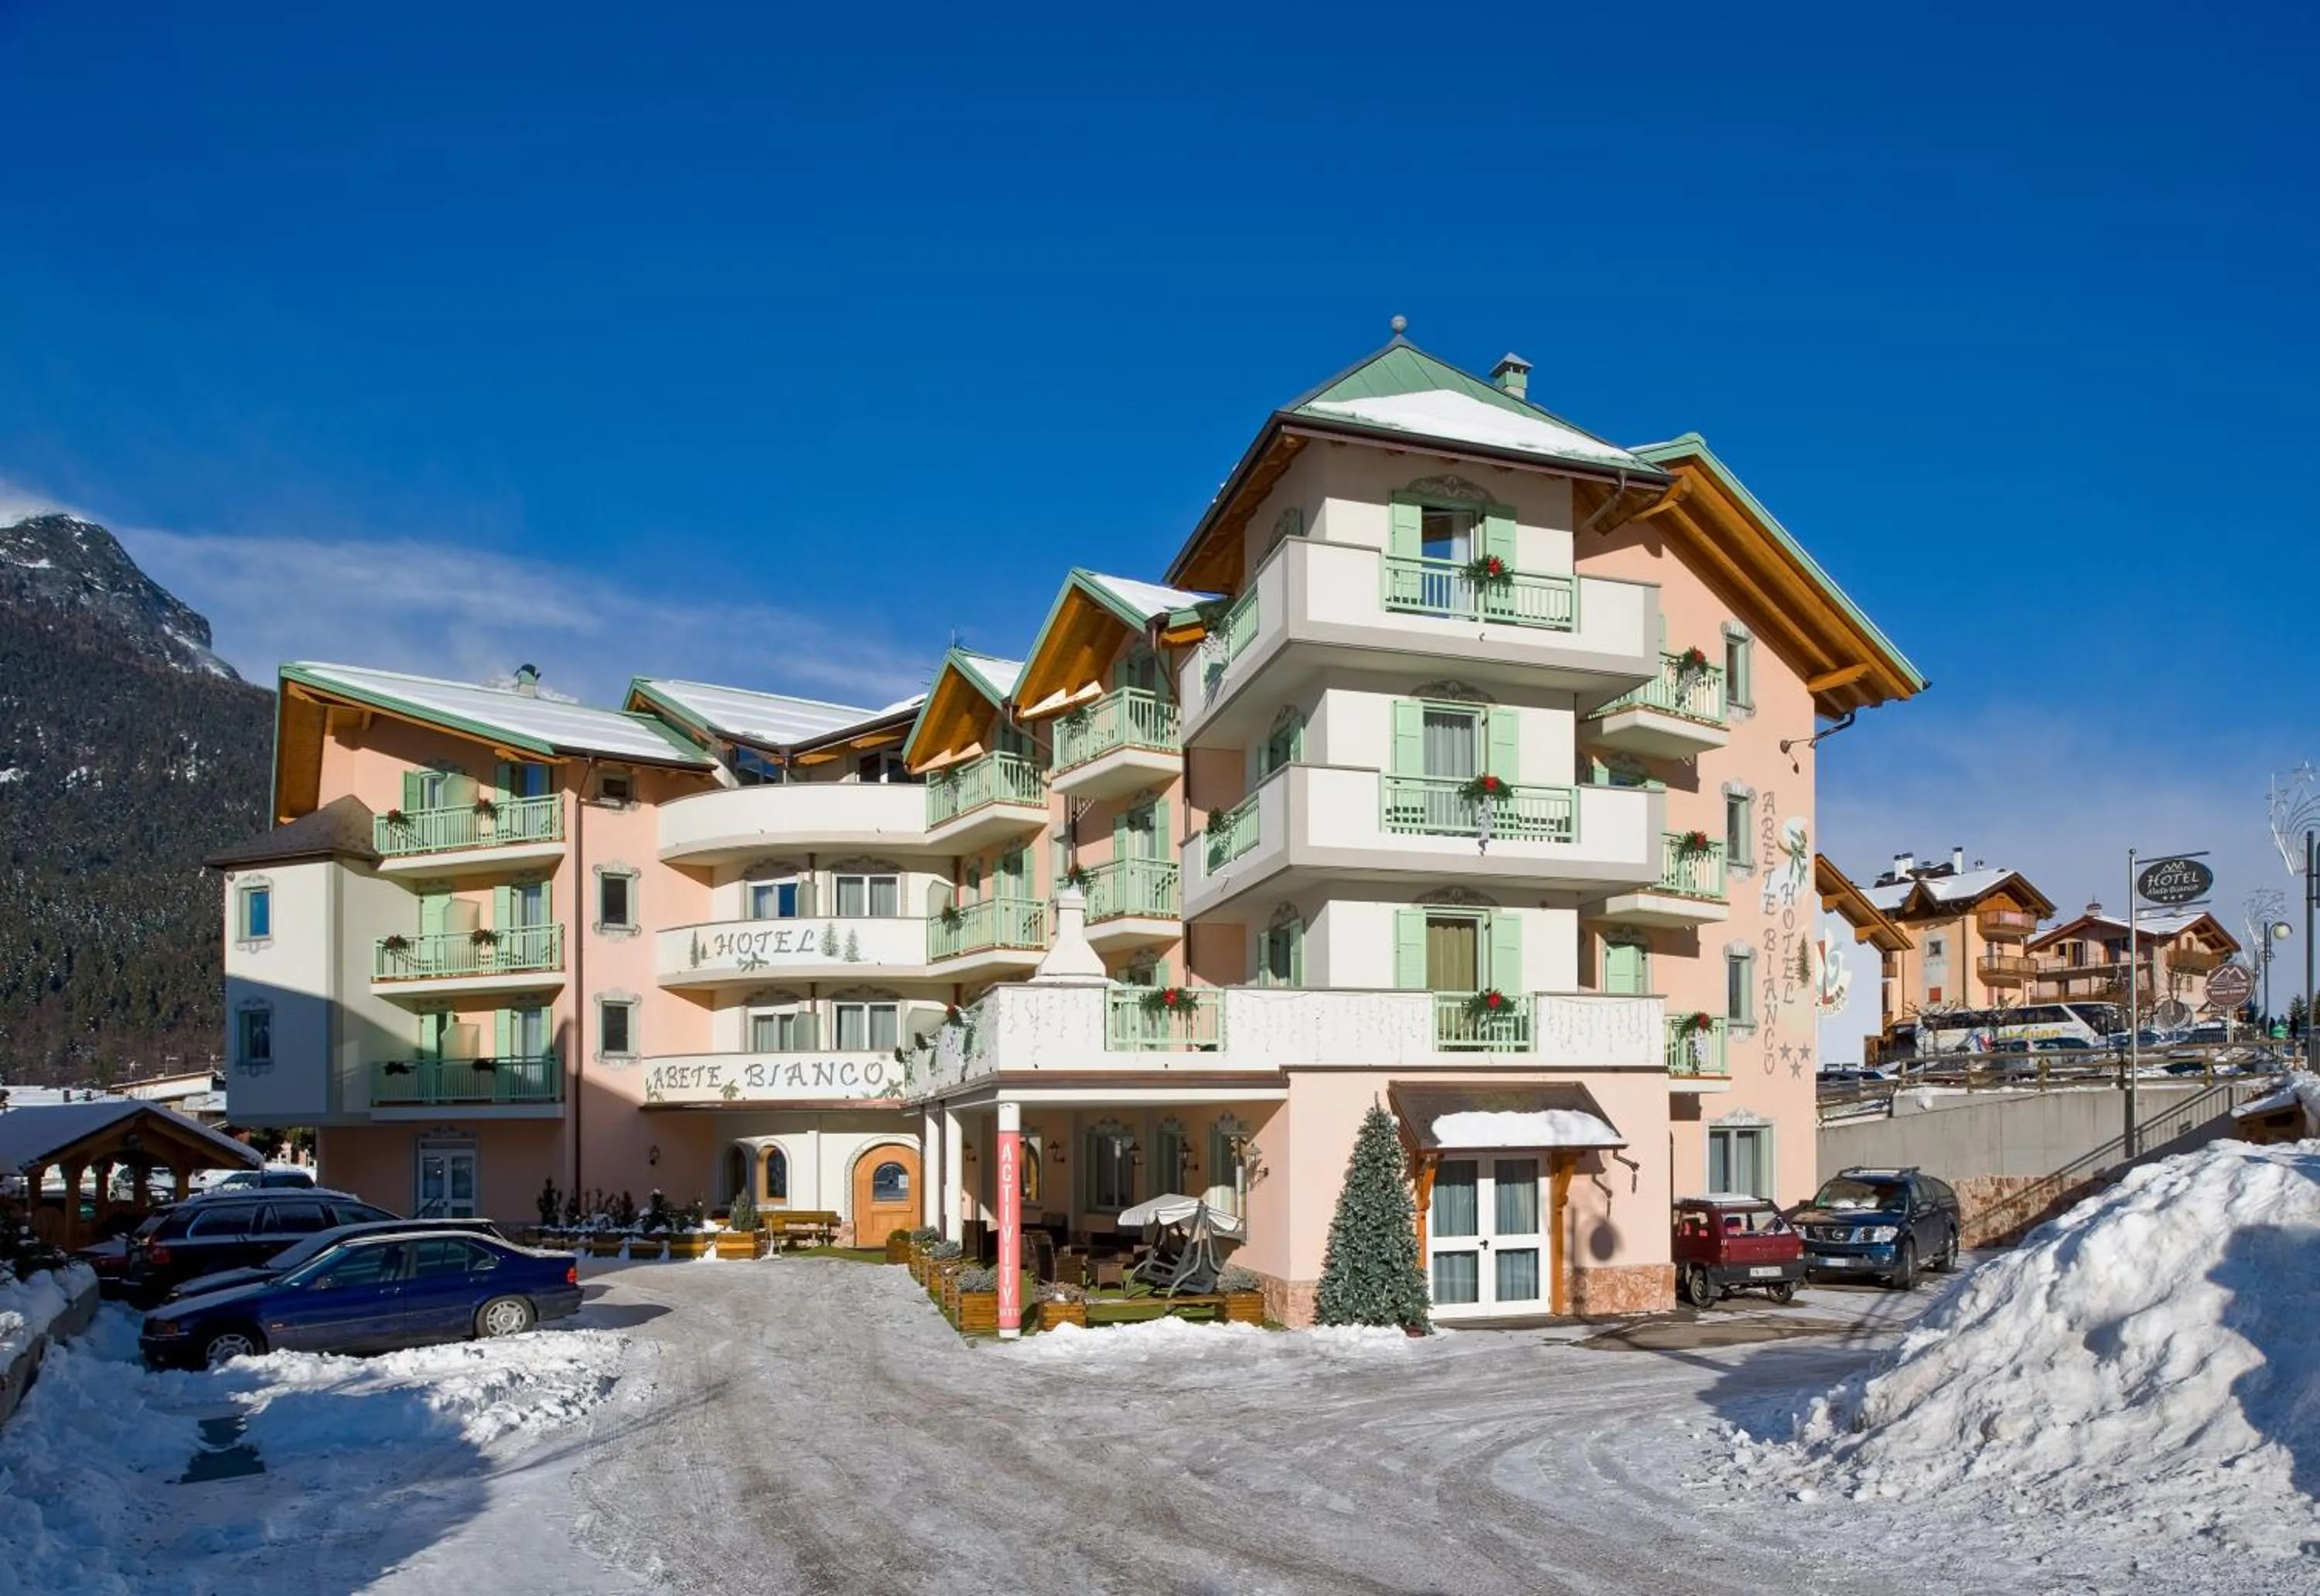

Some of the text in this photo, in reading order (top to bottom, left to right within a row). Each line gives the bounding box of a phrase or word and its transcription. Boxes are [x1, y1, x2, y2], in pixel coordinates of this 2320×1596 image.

[2148, 871, 2199, 888] HOTEL
[714, 929, 815, 957] HOTEL
[1761, 790, 1778, 1076] ABETE BIANCO
[1779, 882, 1796, 1004] HOTEL
[653, 1060, 885, 1090] ABETE BIANCO
[1001, 1142, 1013, 1305] ACTIVITY
